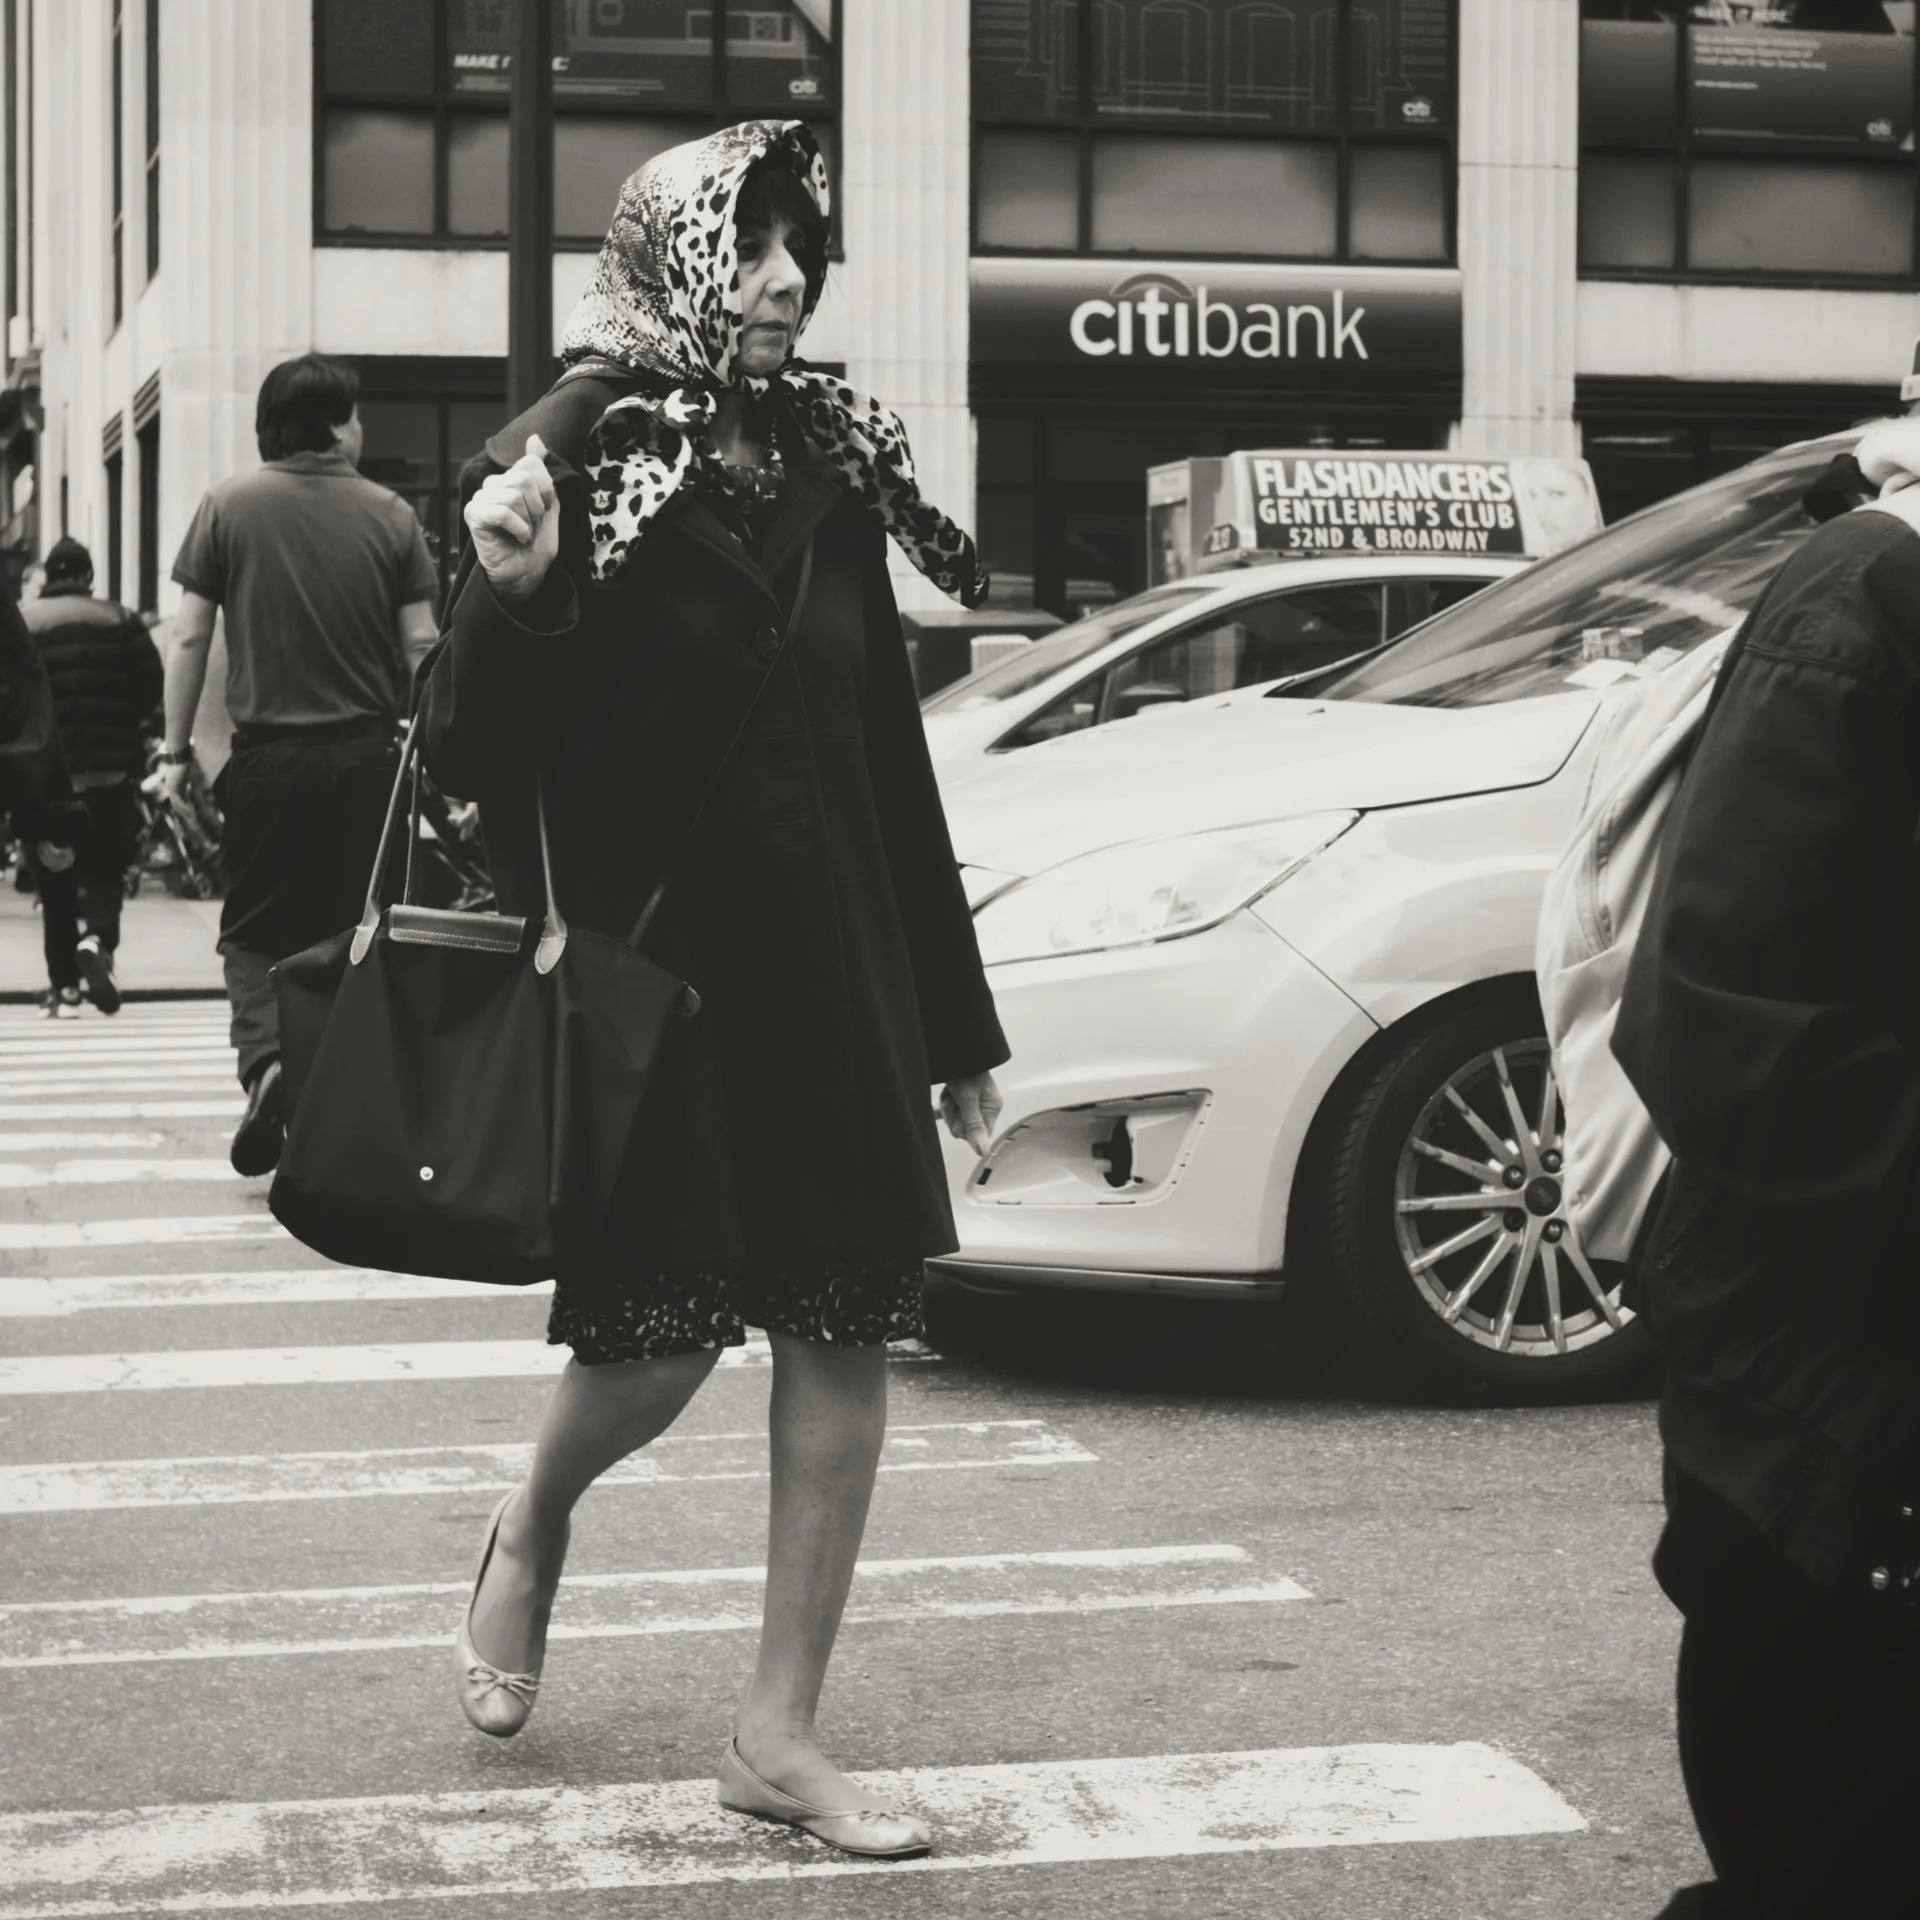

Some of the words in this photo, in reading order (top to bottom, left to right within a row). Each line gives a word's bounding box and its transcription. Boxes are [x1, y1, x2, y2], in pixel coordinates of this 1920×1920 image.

[1070, 285, 1369, 360] citibank
[1253, 459, 1513, 501] FLASHDANCERS
[1258, 498, 1441, 527] GENTLEMEN'S
[1448, 502, 1515, 529] CLUB
[1289, 527, 1345, 549] 52ND
[1352, 528, 1369, 549] &
[1374, 529, 1489, 551] BROADWAY
